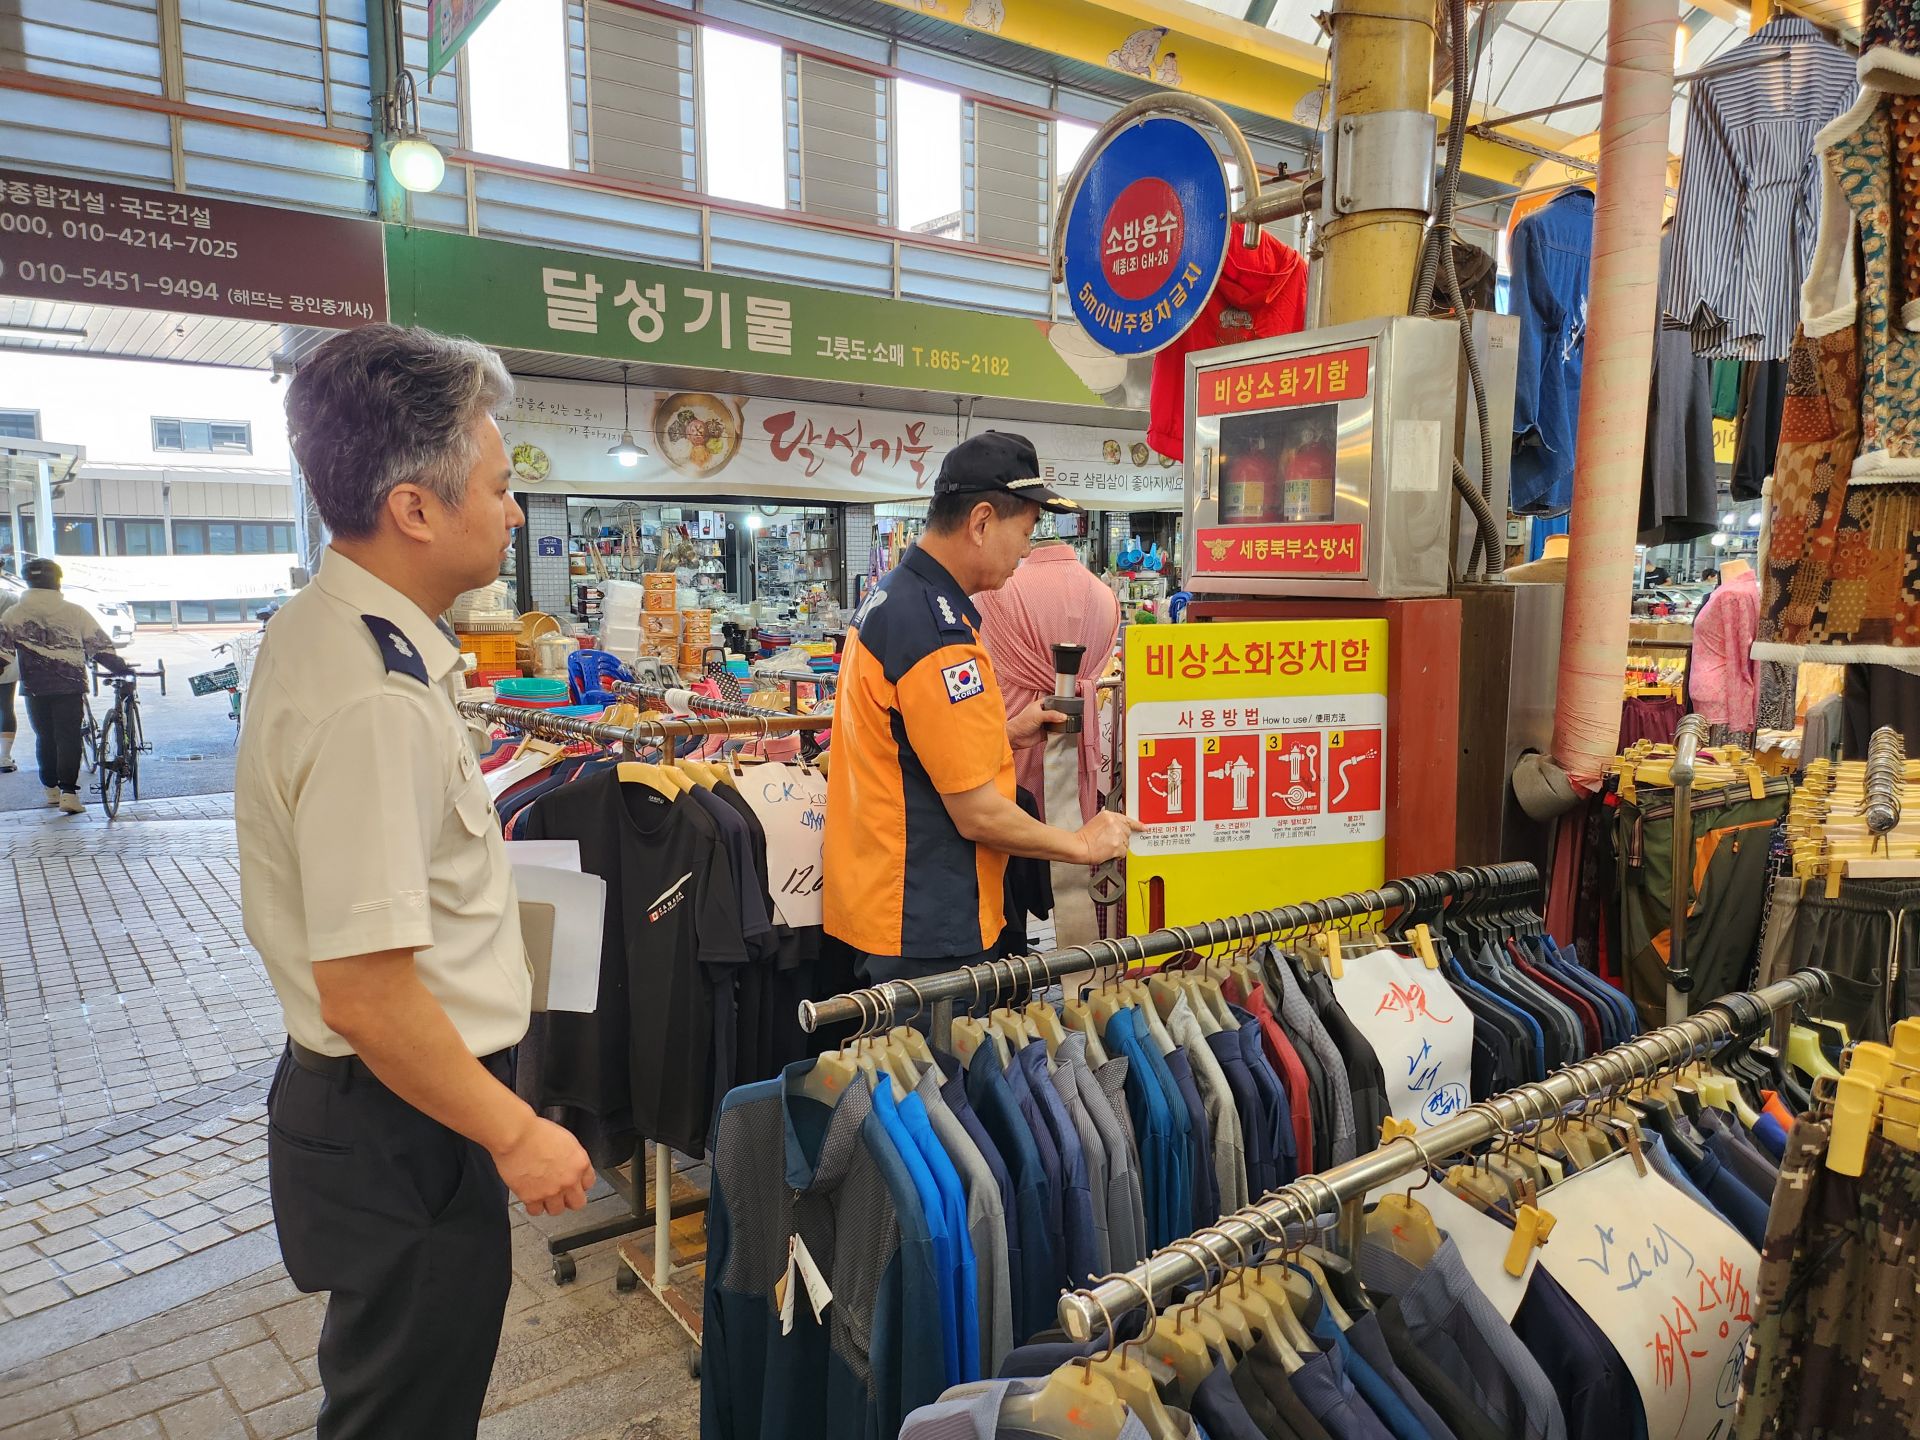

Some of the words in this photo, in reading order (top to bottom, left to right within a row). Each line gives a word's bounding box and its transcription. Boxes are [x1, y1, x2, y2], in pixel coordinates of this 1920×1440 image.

[0, 178, 212, 230] 종합건설·국도건설
[63, 219, 239, 260] 010-4214-7025
[1105, 210, 1179, 256] 소방용수
[18, 260, 219, 302] 010-5451-9494
[227, 288, 284, 310] (해뜨는
[289, 295, 374, 320] 공인중개사)
[541, 266, 794, 357] 달성기물
[911, 347, 1010, 377] T.865-2182
[1214, 359, 1350, 406] 비상소화기함
[550, 403, 590, 417] 있는
[762, 410, 936, 490] 달성기물
[1084, 472, 1128, 490] 살림살이
[1131, 475, 1184, 492] 좋아지세요
[546, 546, 556, 555] 35
[1239, 537, 1355, 561] 세종북부소방서
[1145, 638, 1370, 679] 비상소화장치함
[954, 686, 982, 703] KOREA
[1262, 715, 1280, 725] How
[1282, 716, 1290, 725] to
[1315, 713, 1347, 723] 使用方法
[1142, 742, 1149, 755] 1
[1207, 739, 1216, 752] 2
[1269, 736, 1278, 749] 3
[1331, 733, 1340, 746] 4
[658, 891, 685, 913] CANADA
